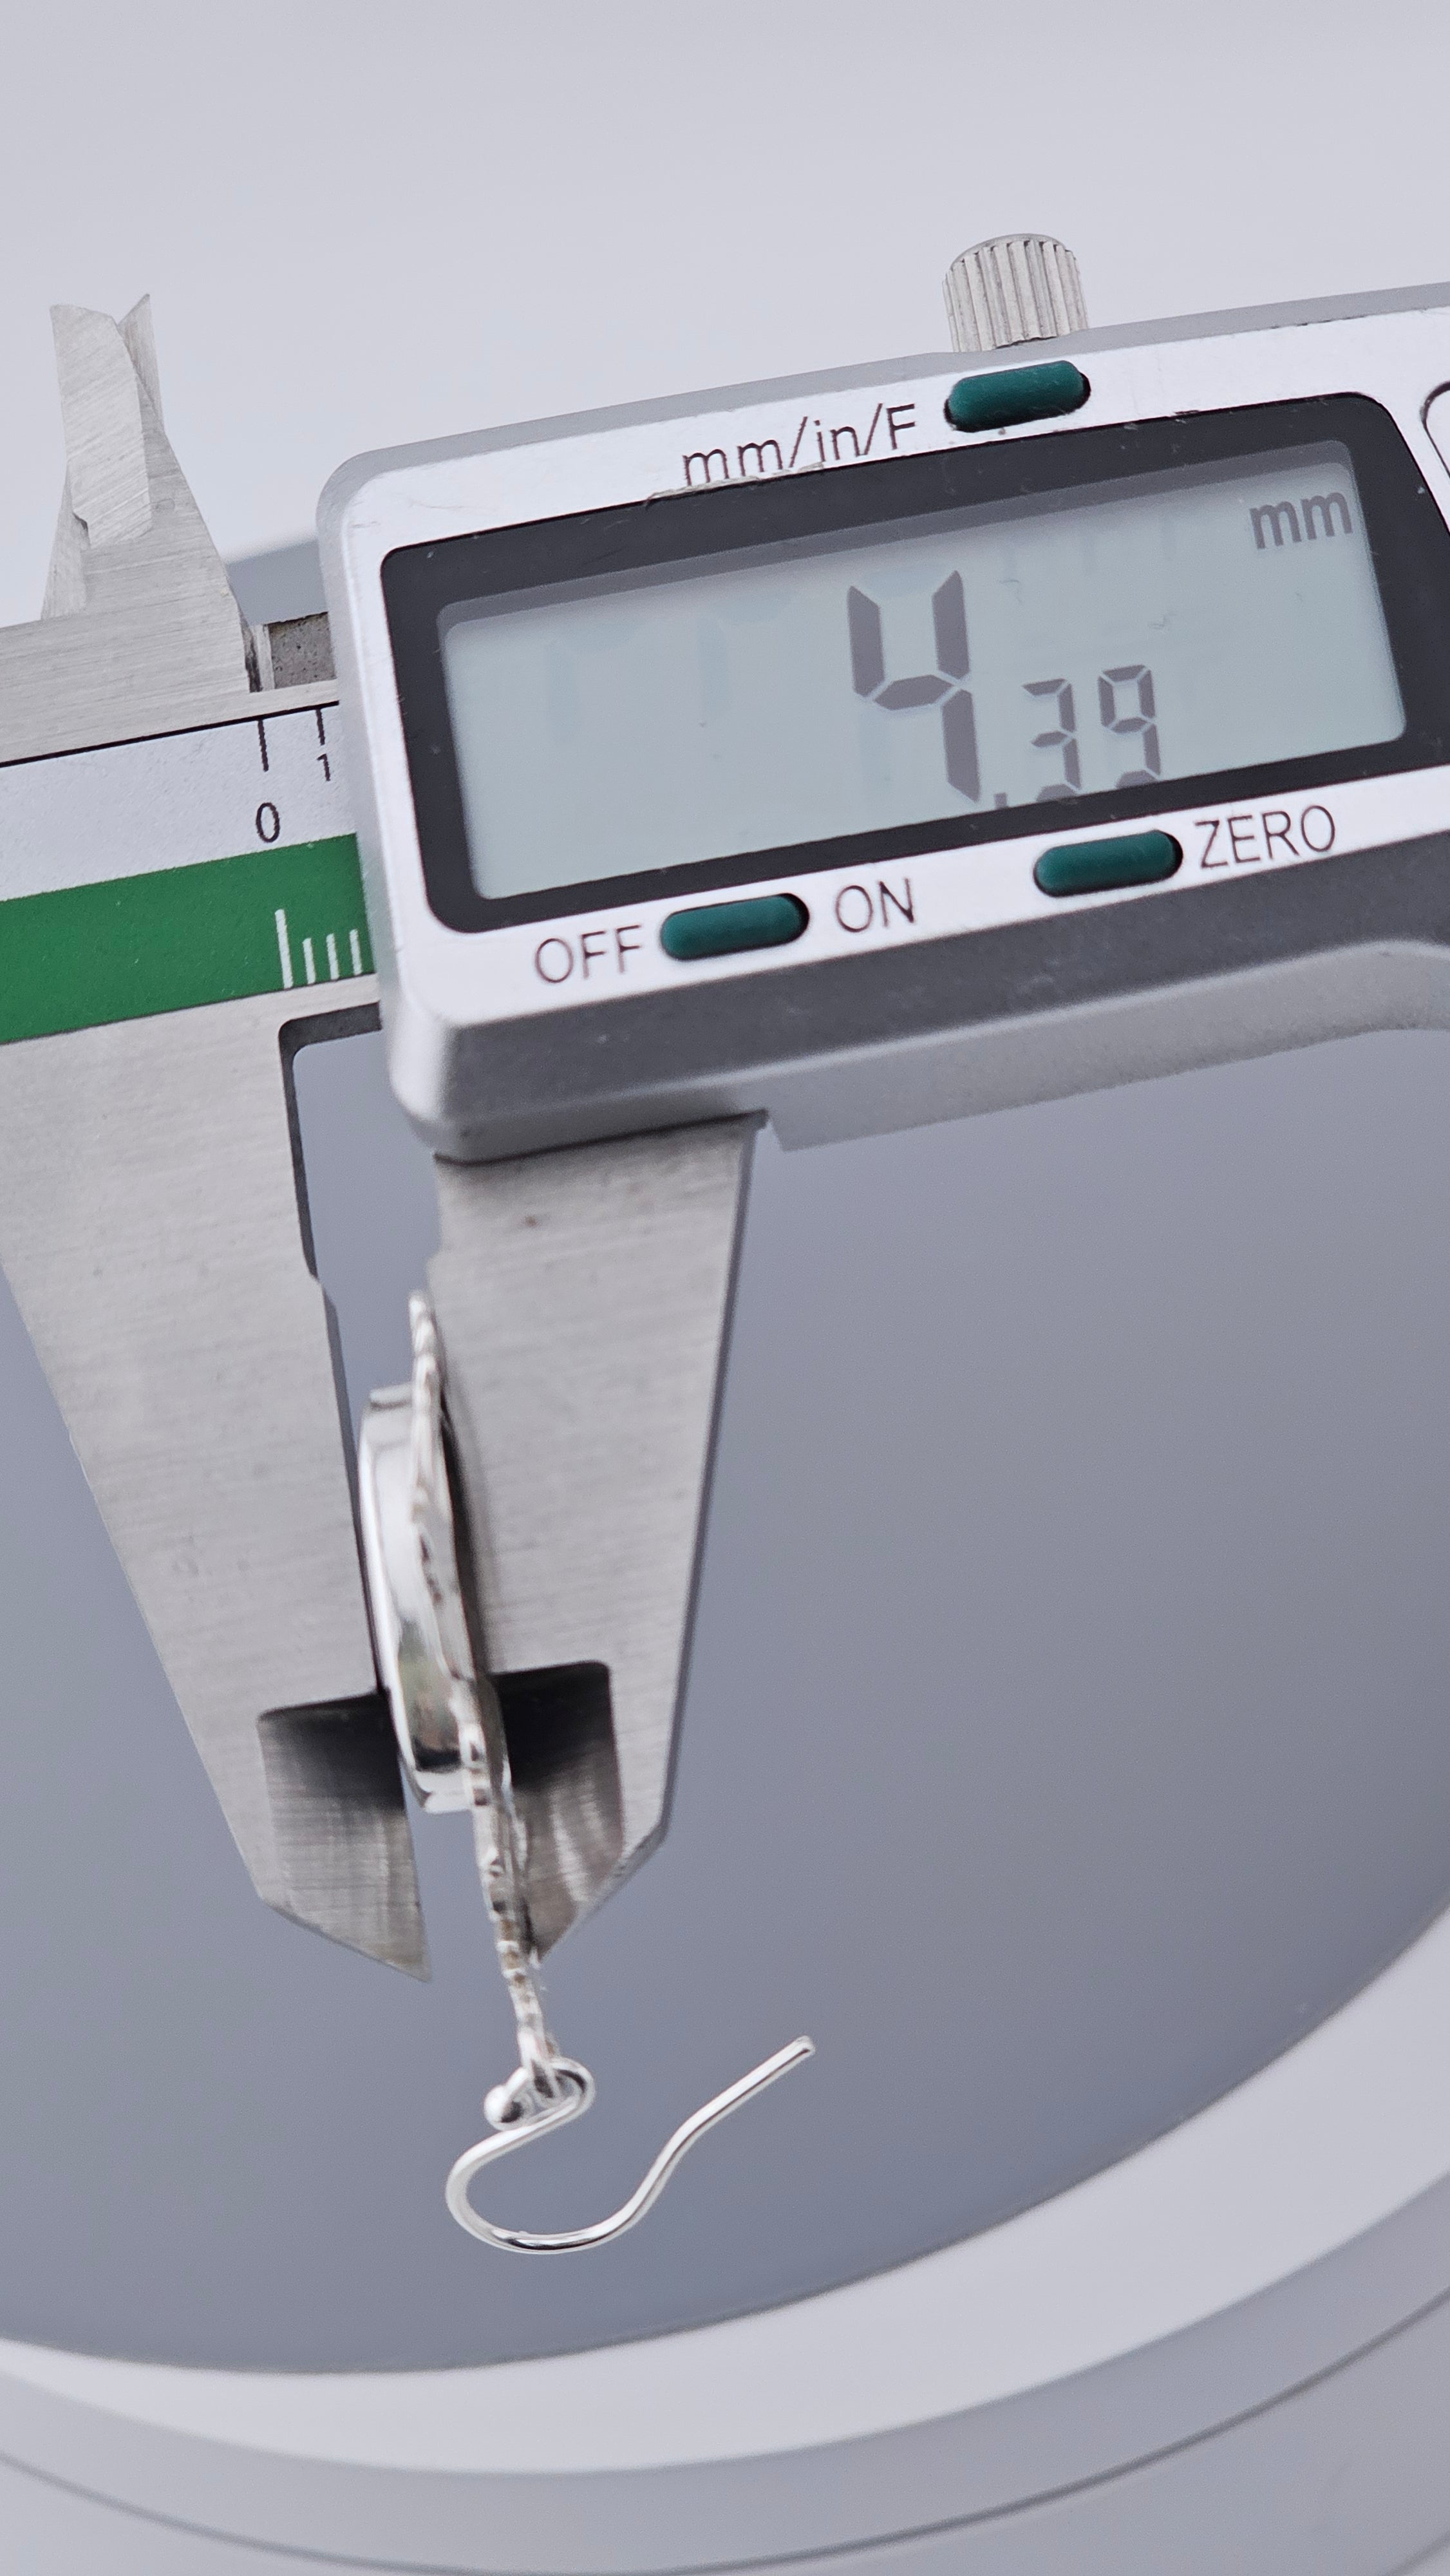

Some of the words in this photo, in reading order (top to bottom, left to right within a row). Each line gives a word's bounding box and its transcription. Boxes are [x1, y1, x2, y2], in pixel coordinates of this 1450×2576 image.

[683, 402, 916, 486] mm/in/F
[1249, 491, 1353, 549] mm
[847, 570, 1161, 811] 4.39
[317, 753, 331, 781] 1
[256, 802, 280, 843] 0
[1194, 804, 1336, 869] ZERO
[534, 923, 643, 983] OFF
[835, 877, 915, 933] ON
